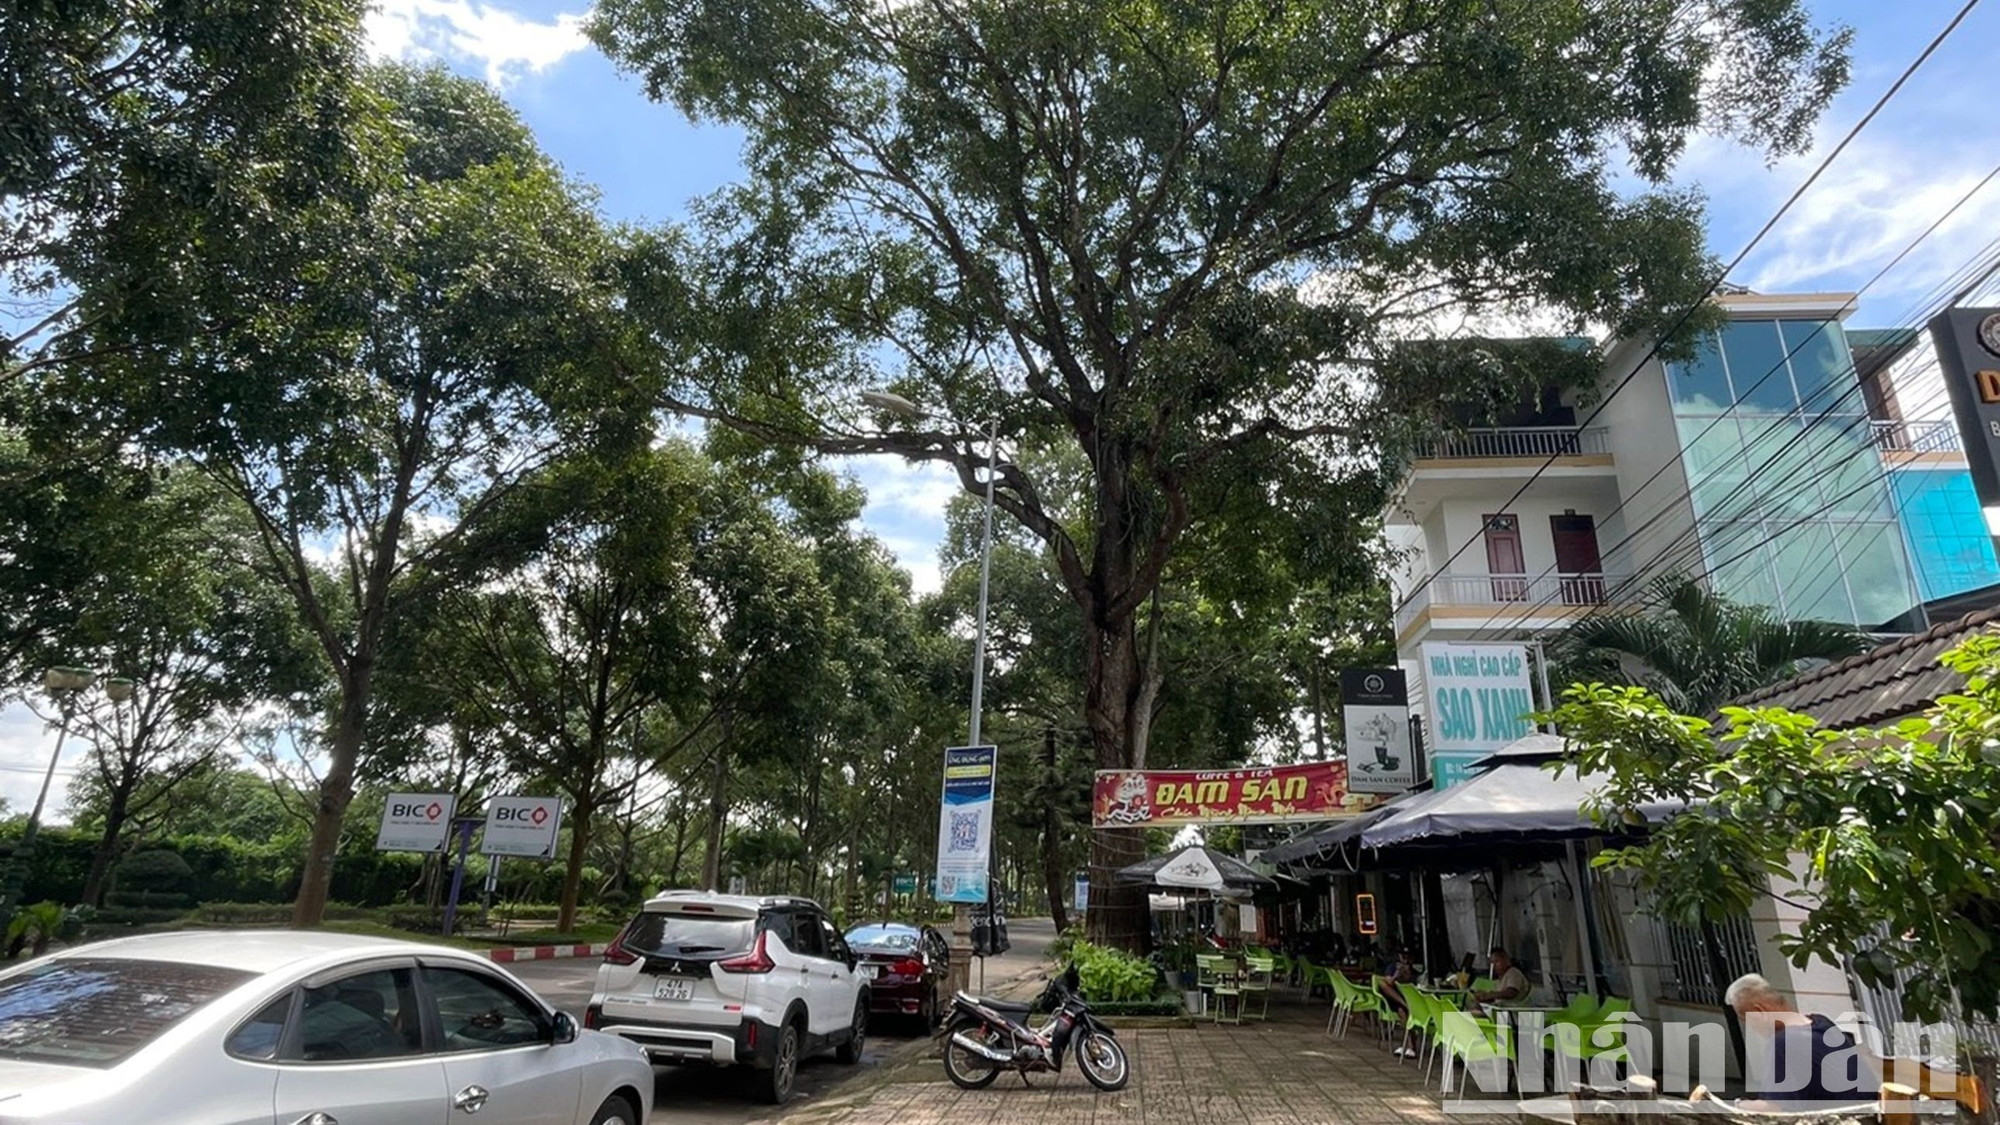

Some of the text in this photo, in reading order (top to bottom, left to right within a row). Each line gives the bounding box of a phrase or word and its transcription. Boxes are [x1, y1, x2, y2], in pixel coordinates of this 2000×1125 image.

[1430, 650, 1522, 677] NHÀ NGHỈ CAO CẤP
[1436, 687, 1531, 741] SAO XANH
[1241, 776, 1308, 802] SAN
[391, 804, 427, 817] BIC
[496, 807, 531, 821] BIC
[666, 979, 684, 988] 47A
